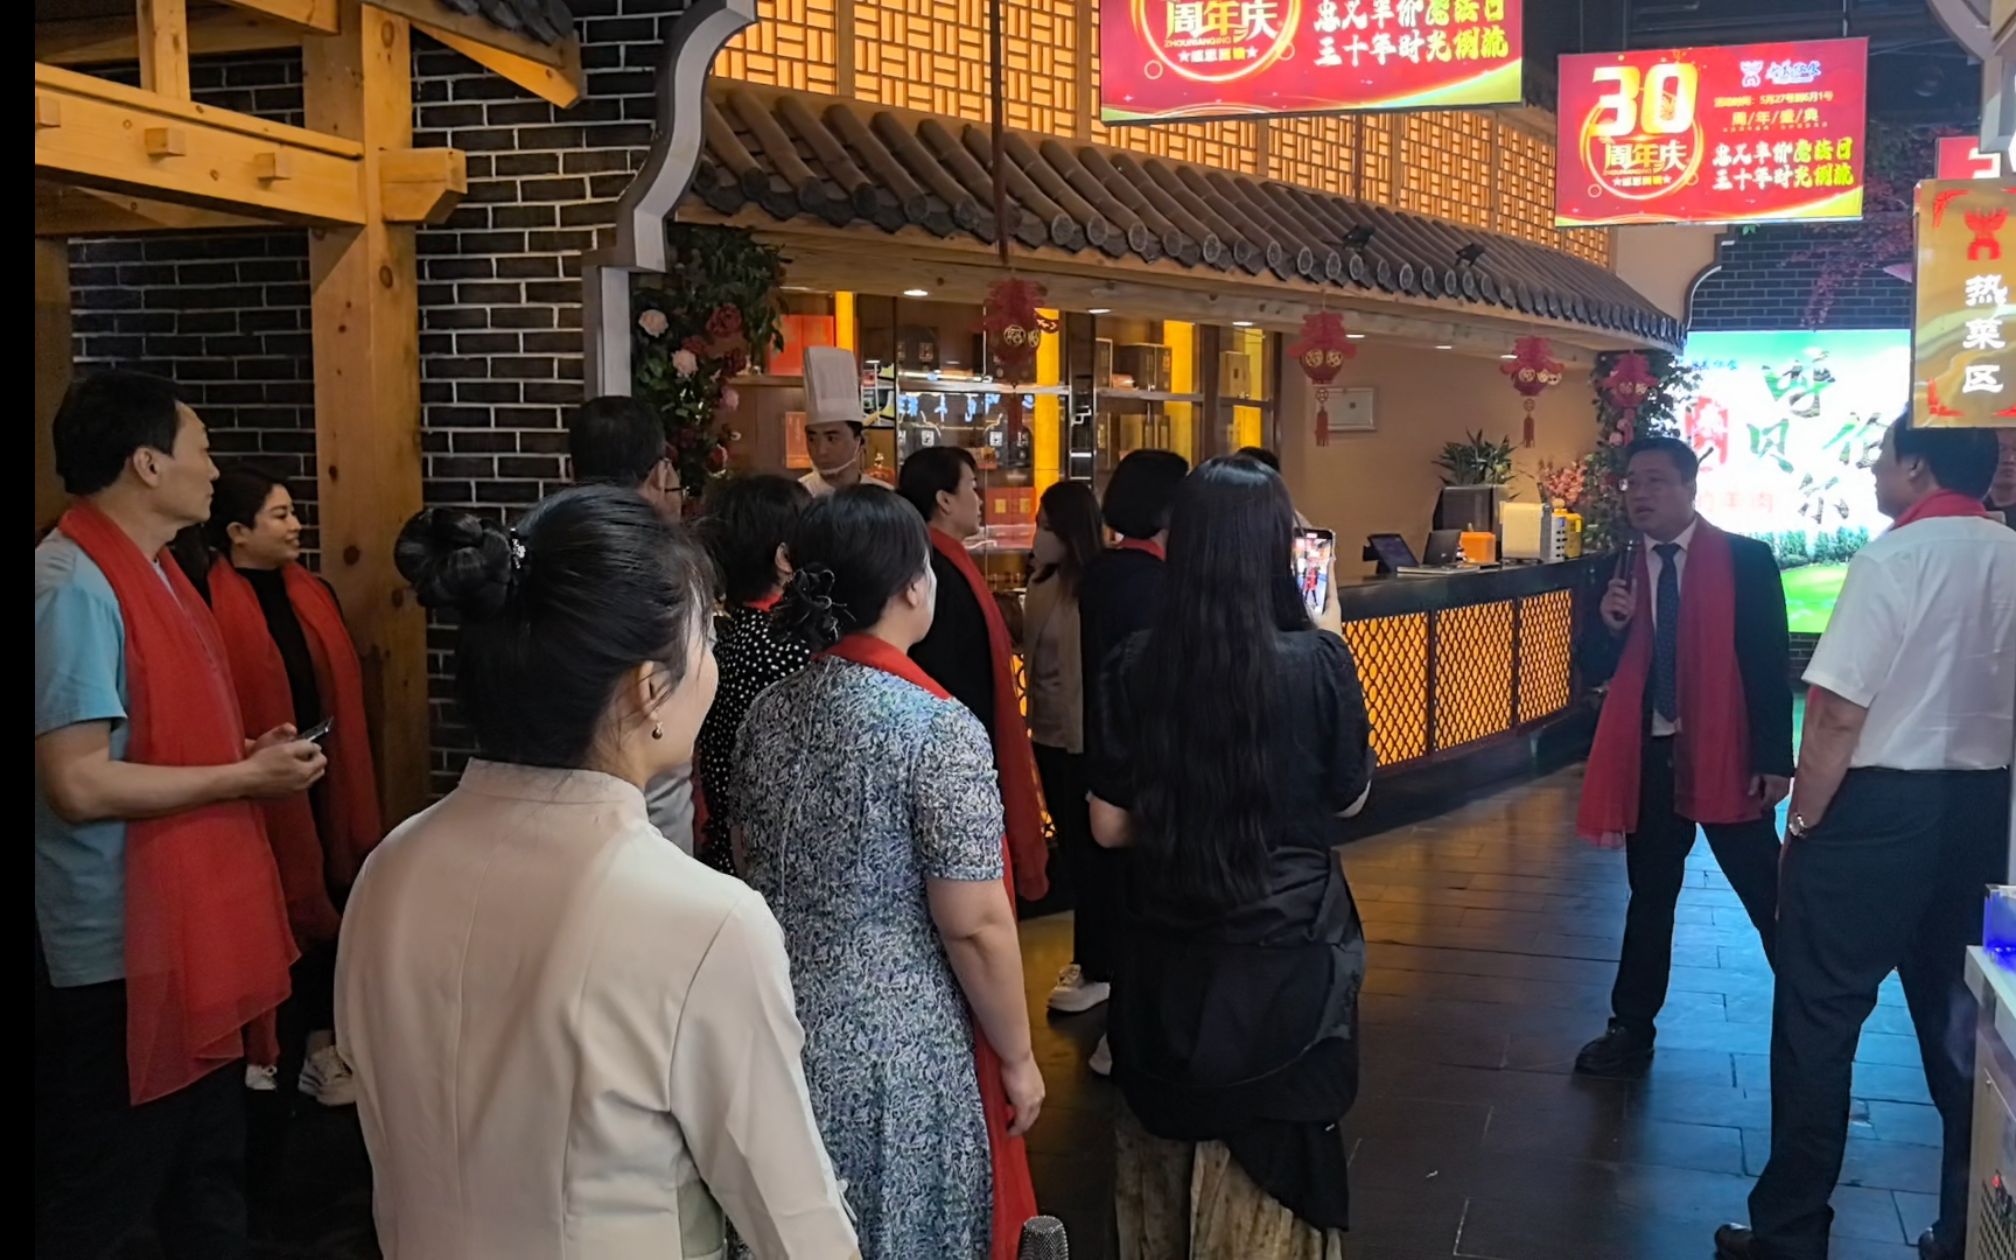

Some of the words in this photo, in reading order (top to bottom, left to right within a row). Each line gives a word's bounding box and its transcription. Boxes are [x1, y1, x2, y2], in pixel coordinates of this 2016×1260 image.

[1165, 0, 1279, 42] 周年庆
[1313, 25, 1509, 67] 三十年时光倒流
[1590, 63, 1698, 137] 30
[1603, 139, 1687, 172] 周年庆
[1712, 162, 1855, 192] 三十年时光倒流
[1962, 274, 2008, 395] 热菜区
